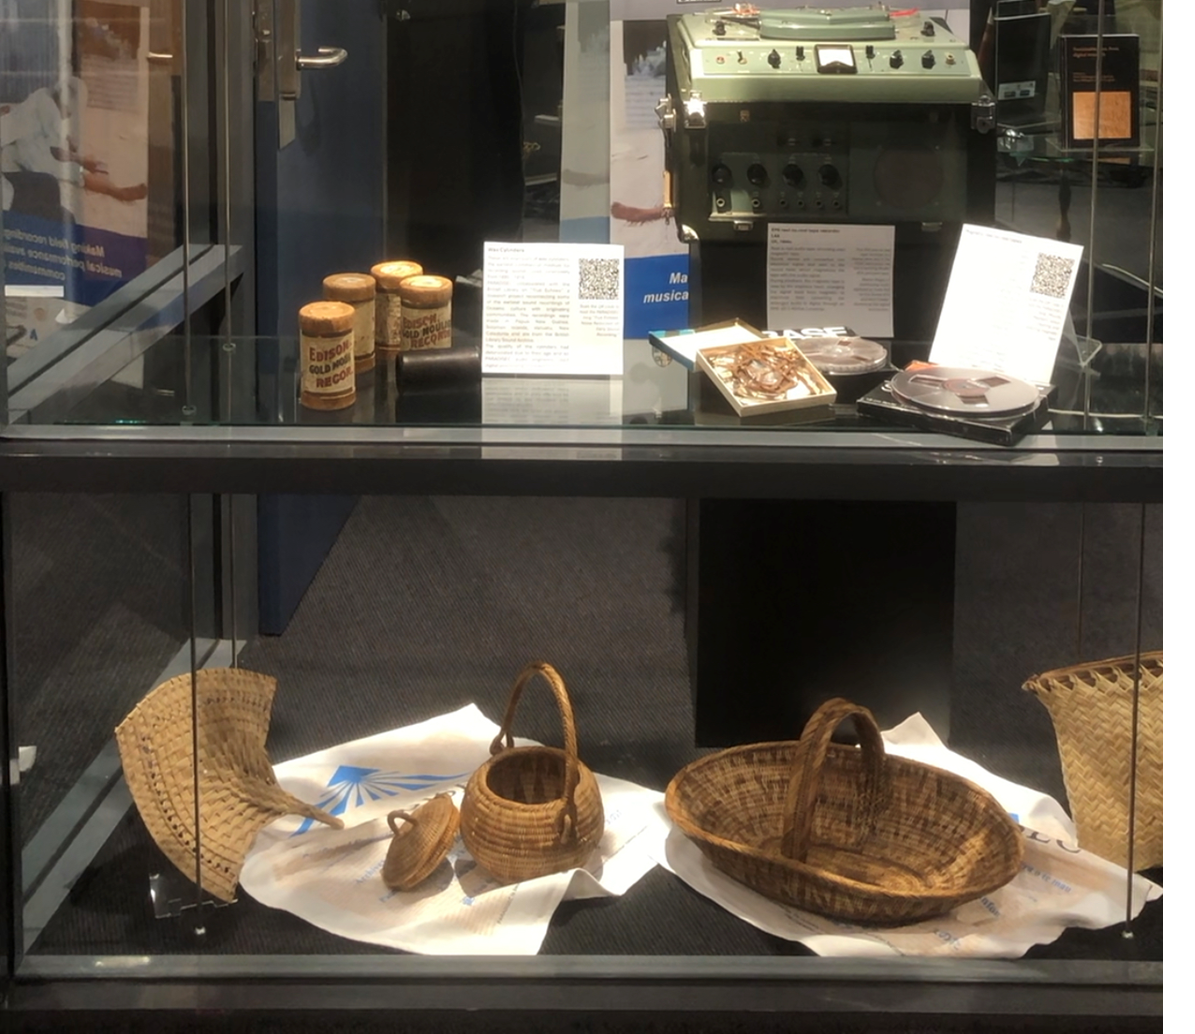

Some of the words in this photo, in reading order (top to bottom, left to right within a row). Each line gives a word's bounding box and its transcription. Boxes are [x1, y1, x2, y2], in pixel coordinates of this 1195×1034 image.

[669, 272, 688, 285] Ma
[643, 290, 689, 304] musica
[309, 364, 331, 375] GOLD
